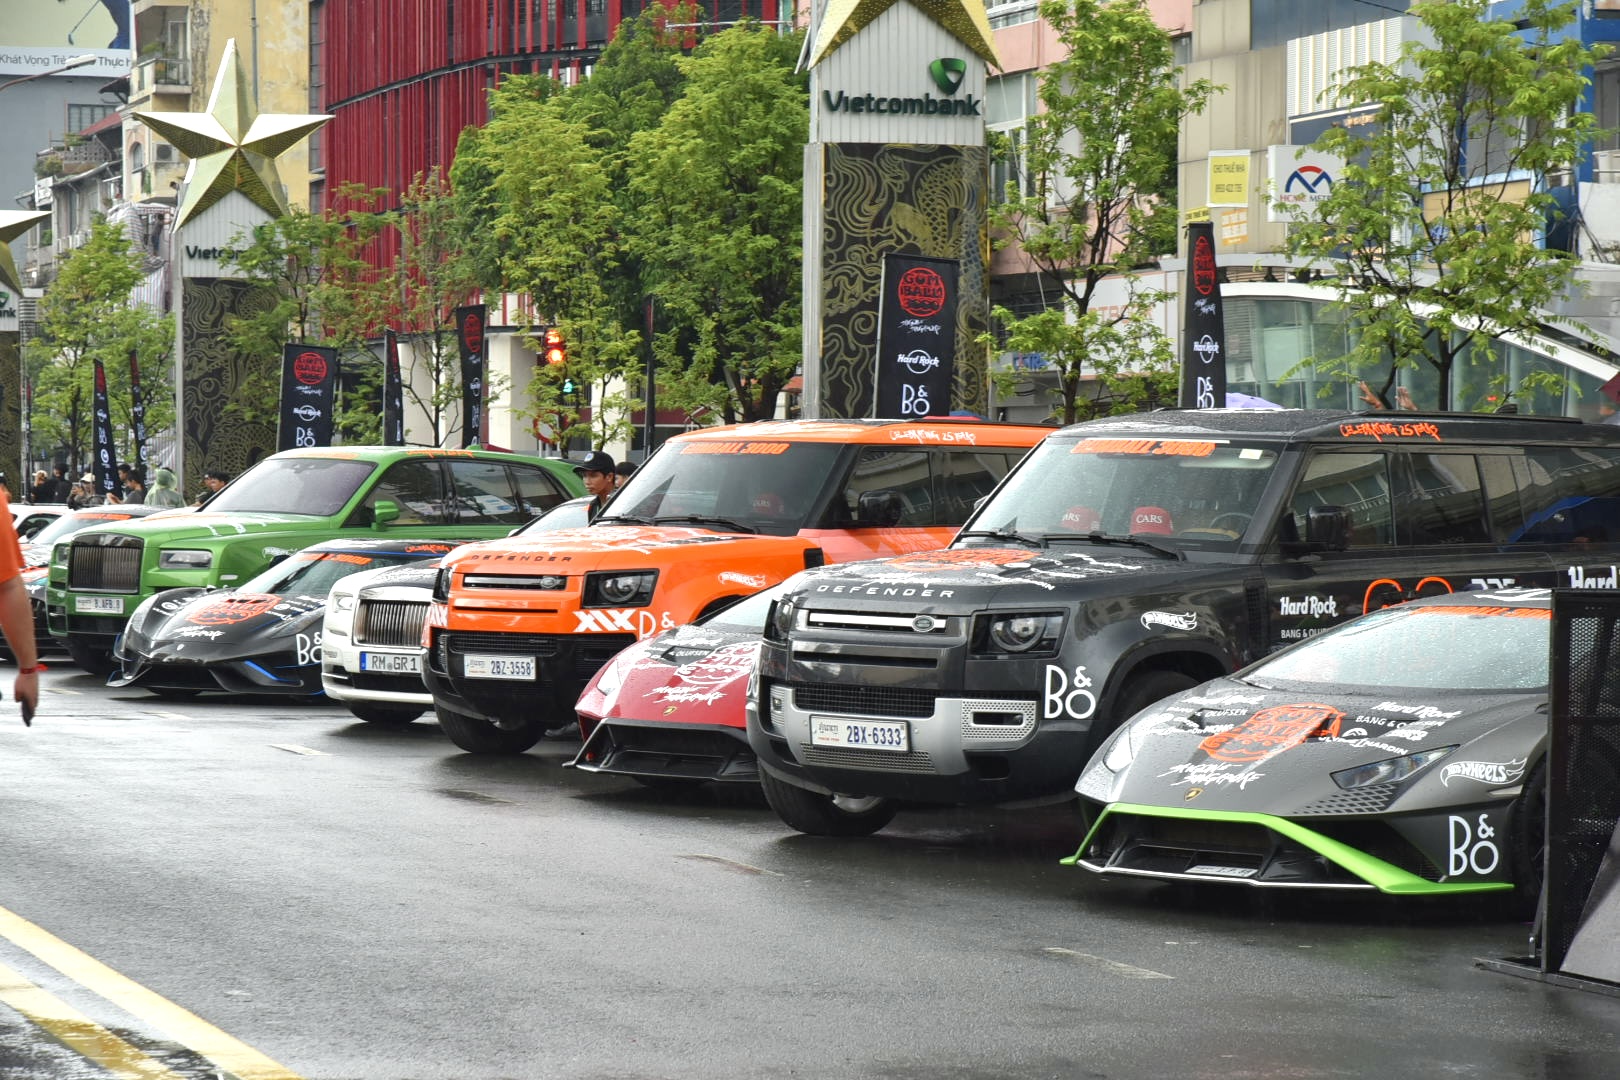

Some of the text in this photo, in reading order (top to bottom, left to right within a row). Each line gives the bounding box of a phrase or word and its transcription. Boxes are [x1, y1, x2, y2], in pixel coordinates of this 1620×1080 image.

[824, 90, 981, 116] Vietcombank
[897, 353, 941, 368] Hard Rock
[942, 431, 955, 442] 25
[1400, 423, 1414, 436] 25
[1136, 514, 1163, 524] CARS
[471, 554, 572, 562] DEFENDER
[816, 584, 955, 599] DEFENDER
[1279, 595, 1339, 618] Hard Rock
[1280, 629, 1302, 639] BANG
[1302, 629, 1308, 639] &
[371, 655, 388, 671] RM
[490, 660, 532, 676] 2BZ-3558
[1355, 715, 1388, 726] BANG
[846, 725, 901, 746] 2BX-6333
